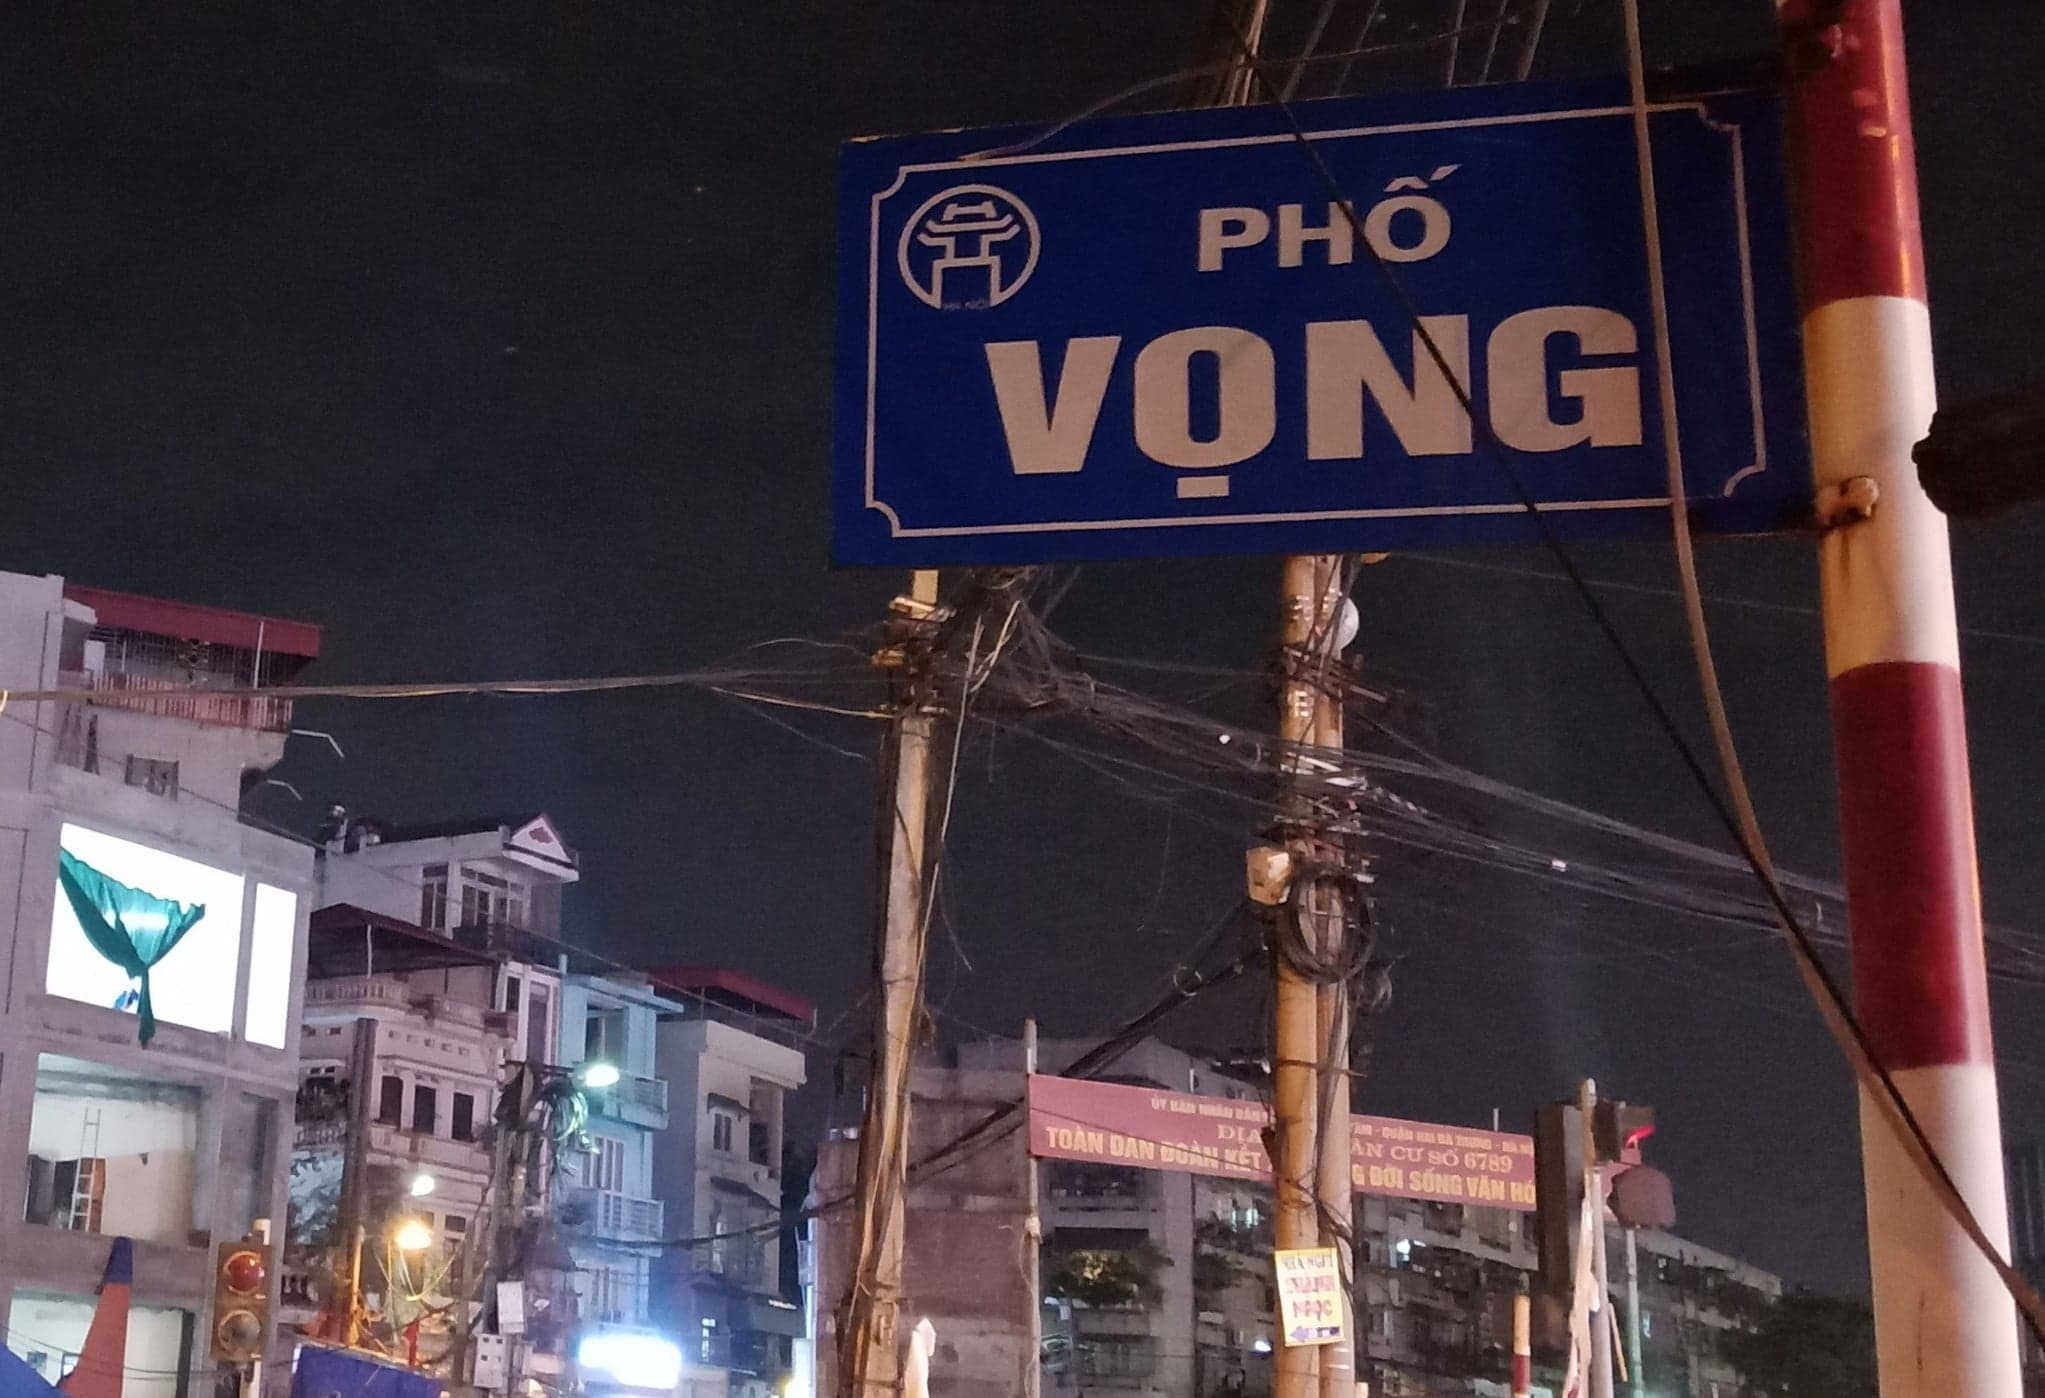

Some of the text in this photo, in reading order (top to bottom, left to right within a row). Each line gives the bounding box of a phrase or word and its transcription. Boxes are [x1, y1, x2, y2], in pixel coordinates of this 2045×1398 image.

[1198, 164, 1462, 272] PHỐ
[984, 305, 1643, 498] VỌNG
[1045, 1125, 1104, 1155] TOÀN
[1160, 1139, 1219, 1169] ĐOÀN
[1224, 1143, 1261, 1172] KẾT
[1408, 1167, 1463, 1196] SỐNG
[1465, 1175, 1505, 1201] VĂN
[1510, 1180, 1536, 1204] HÓ
[1351, 1137, 1384, 1158] ÂN
[1390, 1145, 1424, 1162] CƯ
[1428, 1147, 1460, 1167] SỐ
[1463, 1151, 1513, 1173] 6789
